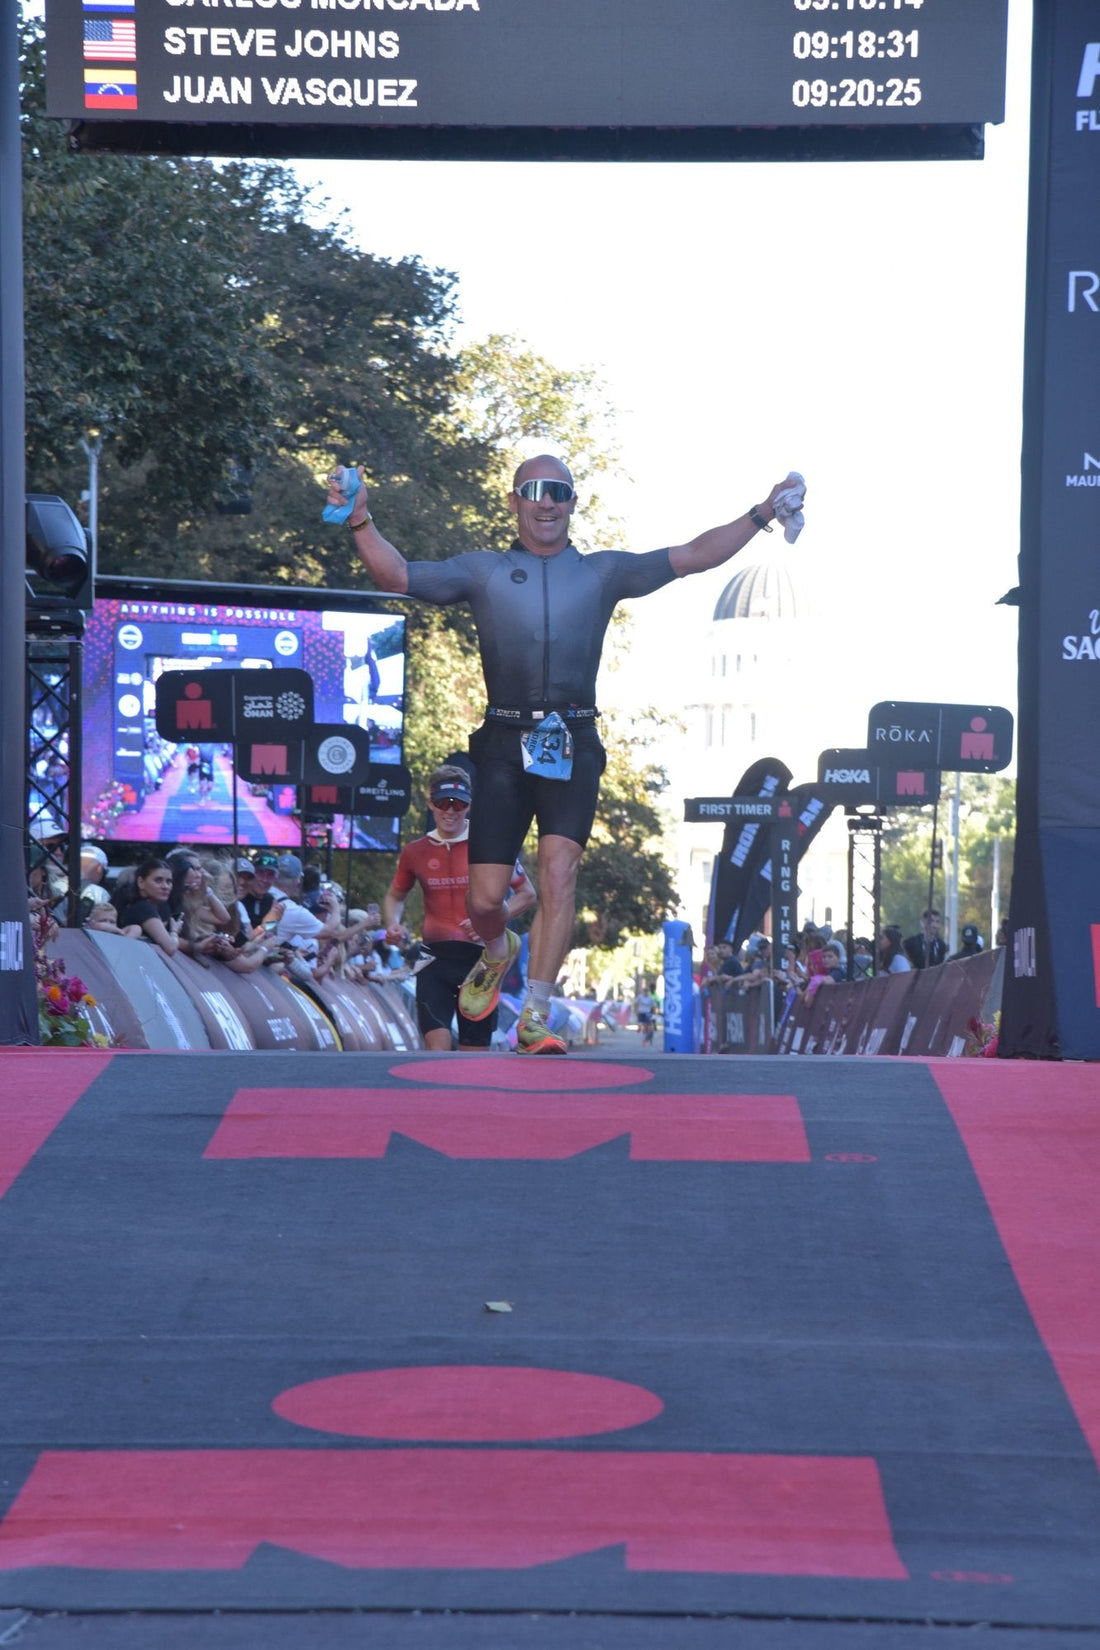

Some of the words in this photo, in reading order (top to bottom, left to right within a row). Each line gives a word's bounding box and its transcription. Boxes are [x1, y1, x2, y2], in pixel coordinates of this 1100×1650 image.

[163, 28, 277, 57] STEVE
[284, 31, 401, 59] JOHNS
[793, 30, 919, 59] 09:18:31
[163, 75, 252, 104] JUAN
[261, 77, 419, 107] VASQUEZ
[792, 78, 922, 107] 09:20:25
[121, 604, 196, 617] ANYTHING
[204, 608, 218, 617] IS
[226, 609, 296, 622] POSSIBLE
[243, 709, 274, 718] OMAN
[824, 768, 871, 784] HOKA
[699, 803, 733, 815] FIRST
[734, 803, 772, 816] TIMER
[781, 838, 792, 893] RING
[665, 968, 683, 1035] HOKA
